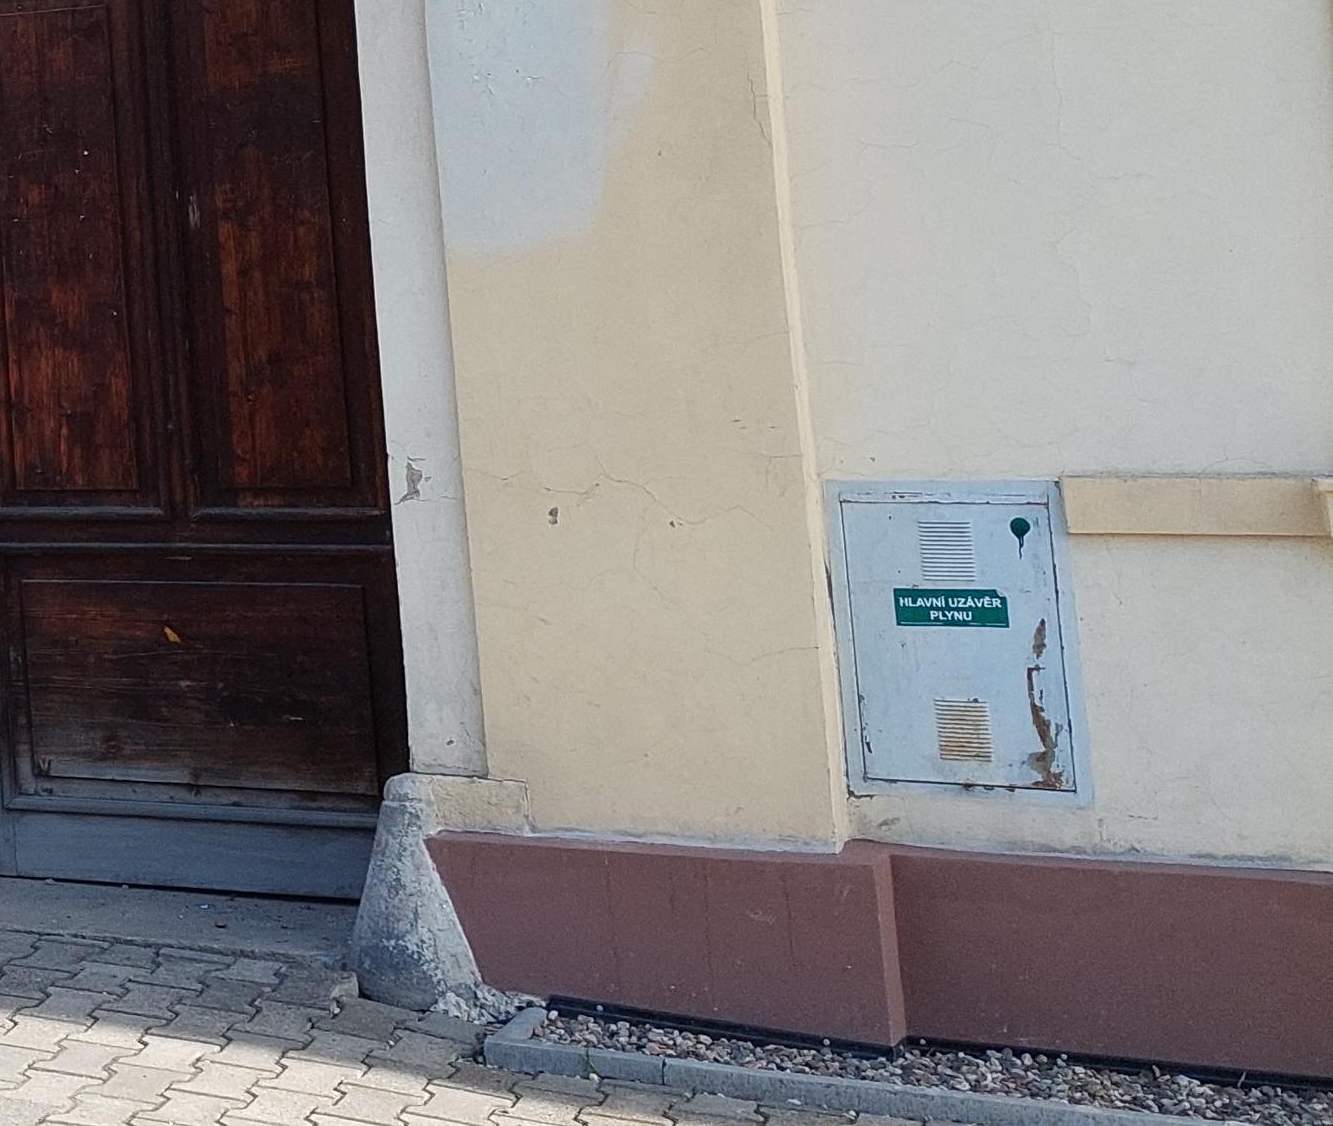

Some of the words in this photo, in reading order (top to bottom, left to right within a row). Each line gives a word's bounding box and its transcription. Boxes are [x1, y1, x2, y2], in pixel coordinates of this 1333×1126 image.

[900, 596, 945, 609] HLAVNÍ
[949, 595, 1002, 609] UZÁVĚR
[930, 610, 973, 621] PLYNU
